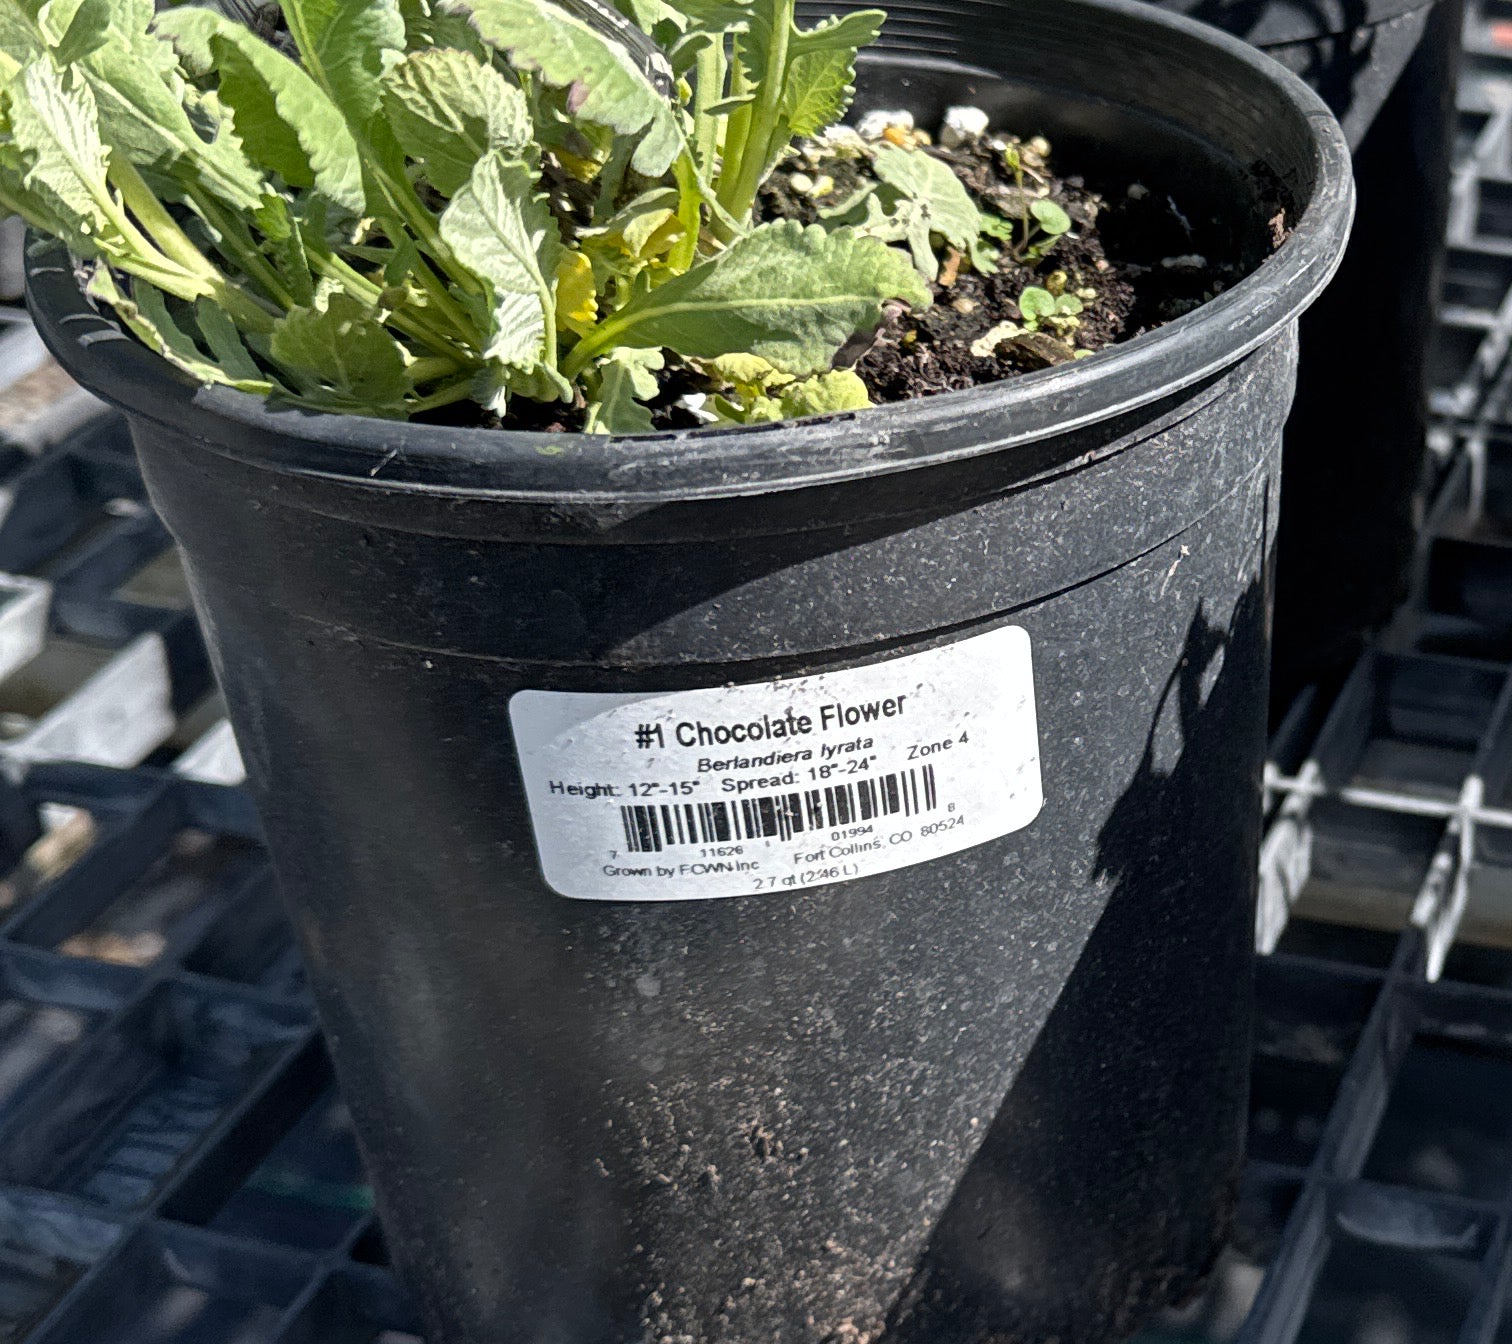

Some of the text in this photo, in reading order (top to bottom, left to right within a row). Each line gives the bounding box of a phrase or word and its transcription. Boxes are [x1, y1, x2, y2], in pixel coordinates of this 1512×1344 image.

[635, 694, 907, 749] #1 Chocolate Flower
[549, 730, 969, 800] Height: 12"-15" Spread: 18"-24" Zone 4
[697, 737, 874, 773] Berlandiera lyrata
[603, 864, 653, 877] Grown
[656, 865, 676, 879] by
[680, 861, 734, 876] FCWN
[794, 848, 825, 865] Fort
[889, 830, 912, 846] CO
[920, 814, 965, 837] 80524
[699, 846, 744, 858] 11626
[831, 825, 874, 842] 01994
[782, 874, 797, 887] qt
[843, 862, 859, 876] L)
